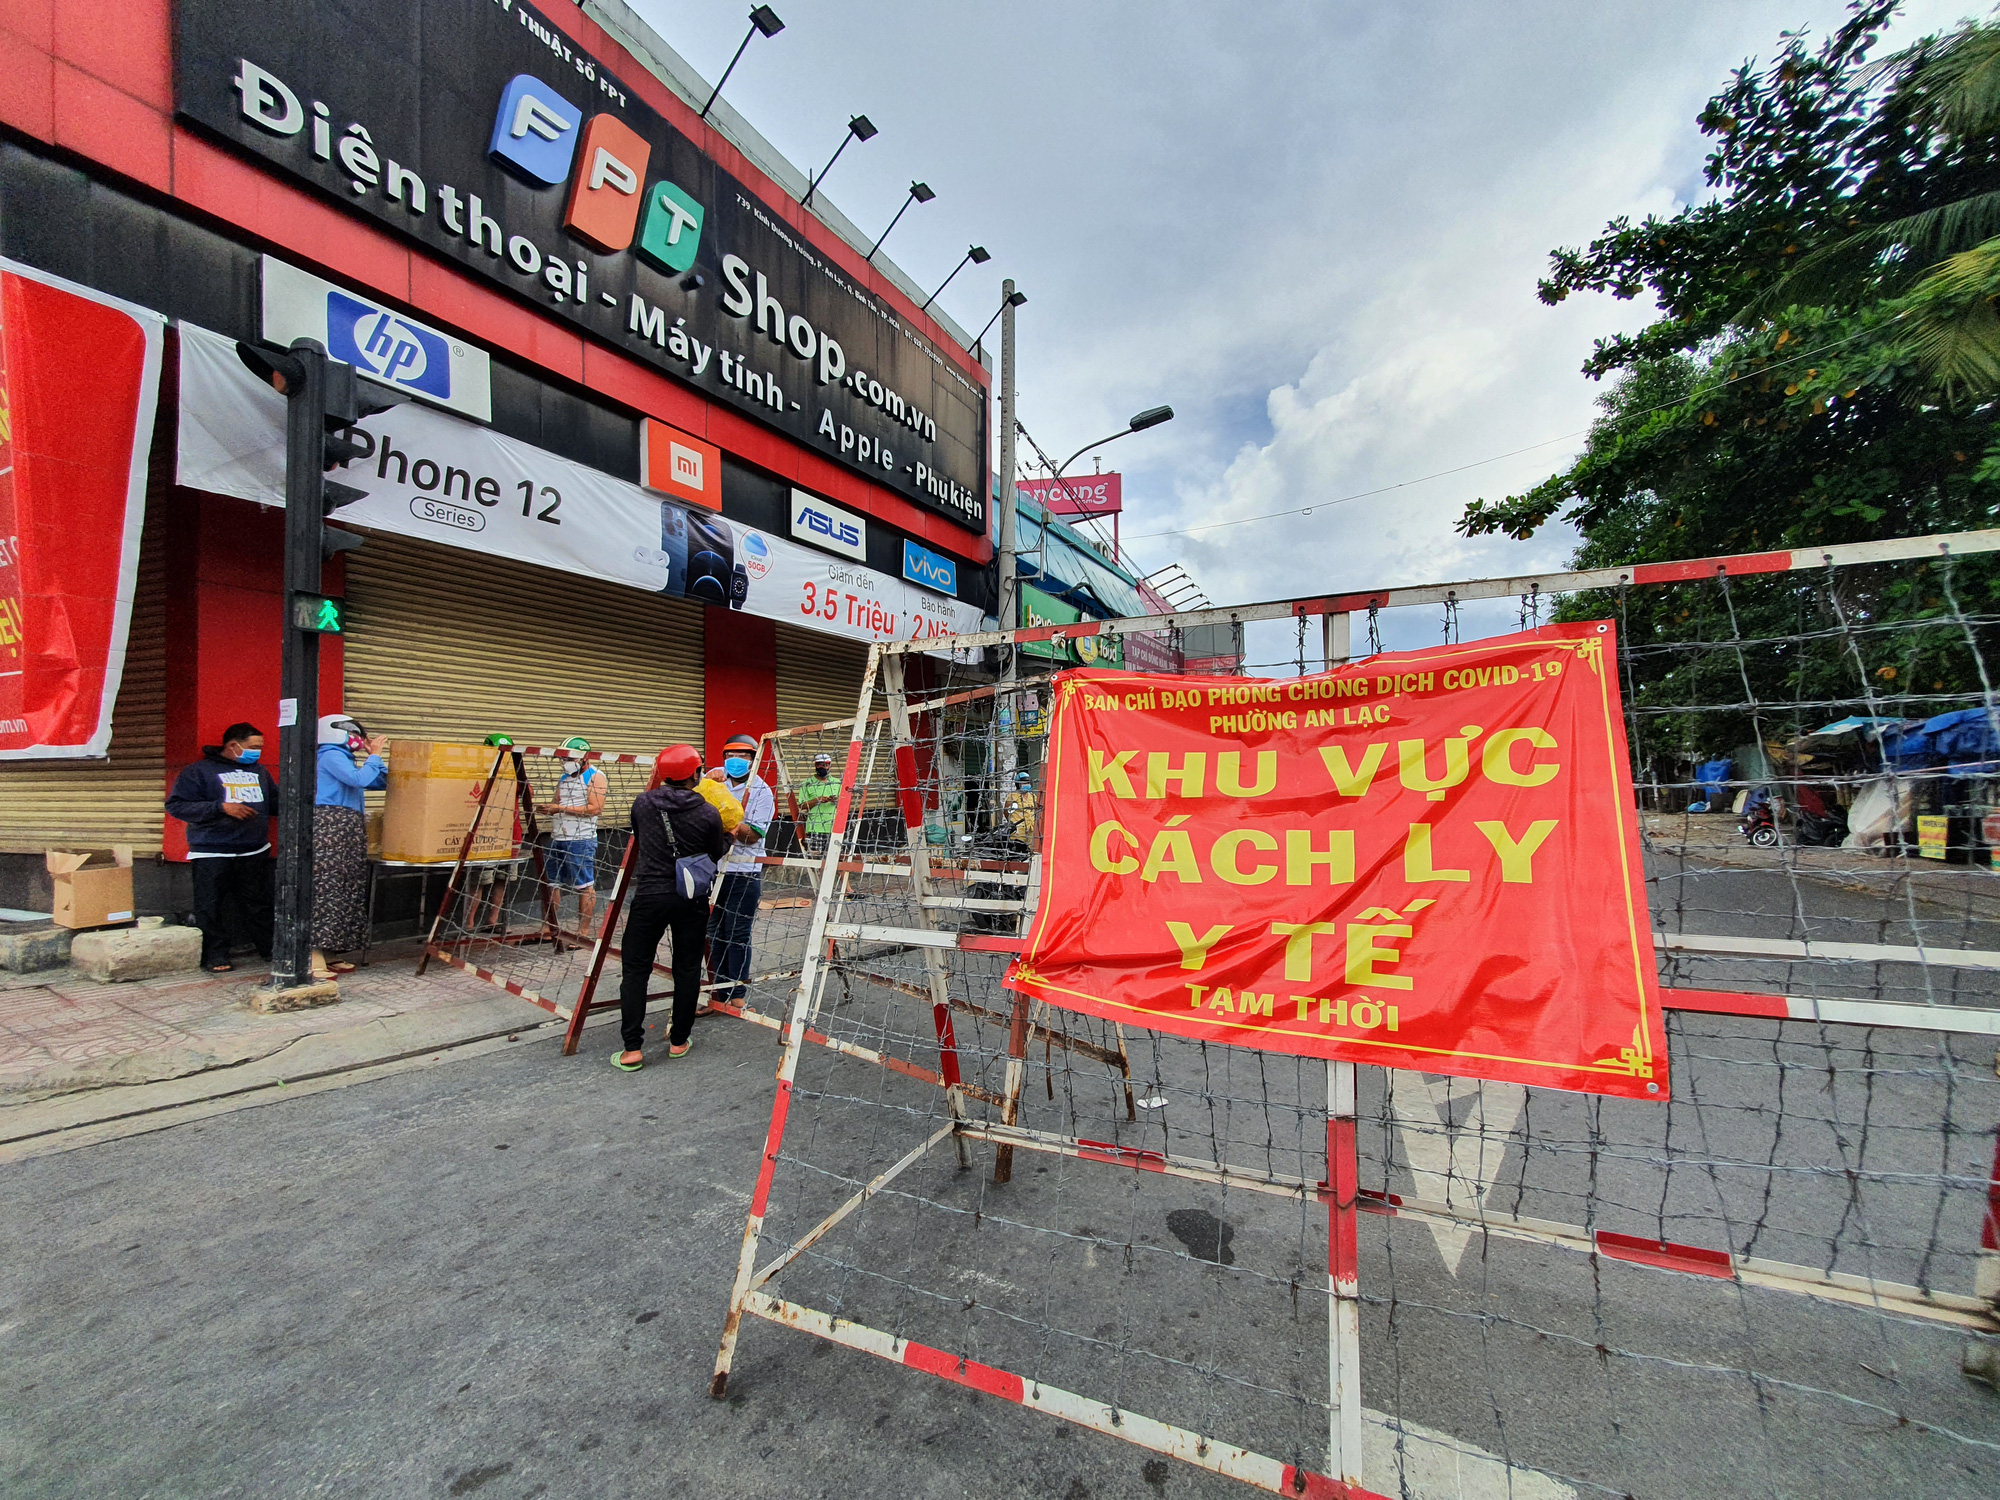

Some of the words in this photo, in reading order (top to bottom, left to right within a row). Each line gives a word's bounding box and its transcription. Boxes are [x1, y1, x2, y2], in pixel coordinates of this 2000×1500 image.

[600, 77, 626, 108] FPT
[511, 94, 698, 245] FPT
[736, 192, 751, 210] 739
[234, 58, 426, 213] Điện
[438, 184, 587, 303] thoại
[629, 293, 712, 374] Máy
[720, 350, 783, 412] tính
[818, 408, 894, 471] Apple
[364, 313, 419, 380] hp
[338, 426, 501, 507] Phone
[517, 479, 562, 526] 12
[424, 502, 475, 528] Series
[796, 506, 860, 547] ASUS
[747, 560, 766, 573] 50GB
[828, 564, 854, 586] Giảm
[856, 571, 874, 592] đến
[909, 555, 951, 586] vivo
[800, 581, 838, 621] 3.5
[845, 593, 895, 639] Triệu
[912, 614, 923, 640] 2
[921, 596, 936, 613] Bảo
[937, 601, 956, 619] hành
[1085, 694, 1119, 711] BAN
[1125, 686, 1155, 711] CHỈ
[1161, 688, 1201, 712] ĐẠO
[1377, 672, 1434, 698] DỊCH
[1443, 660, 1562, 690] COVID-19
[1210, 708, 1297, 734] PHƯỜNG
[1304, 708, 1335, 728] AN
[1343, 704, 1391, 728] LẠC
[1087, 745, 1277, 799] KHU
[1318, 724, 1560, 802] VỰC
[1089, 814, 1356, 887] CÁCH
[1403, 819, 1559, 884] LY
[1165, 920, 1234, 971] Y
[1271, 898, 1437, 991] TẾ
[1184, 982, 1275, 1017] TẠM
[1289, 994, 1399, 1032] THỜI
